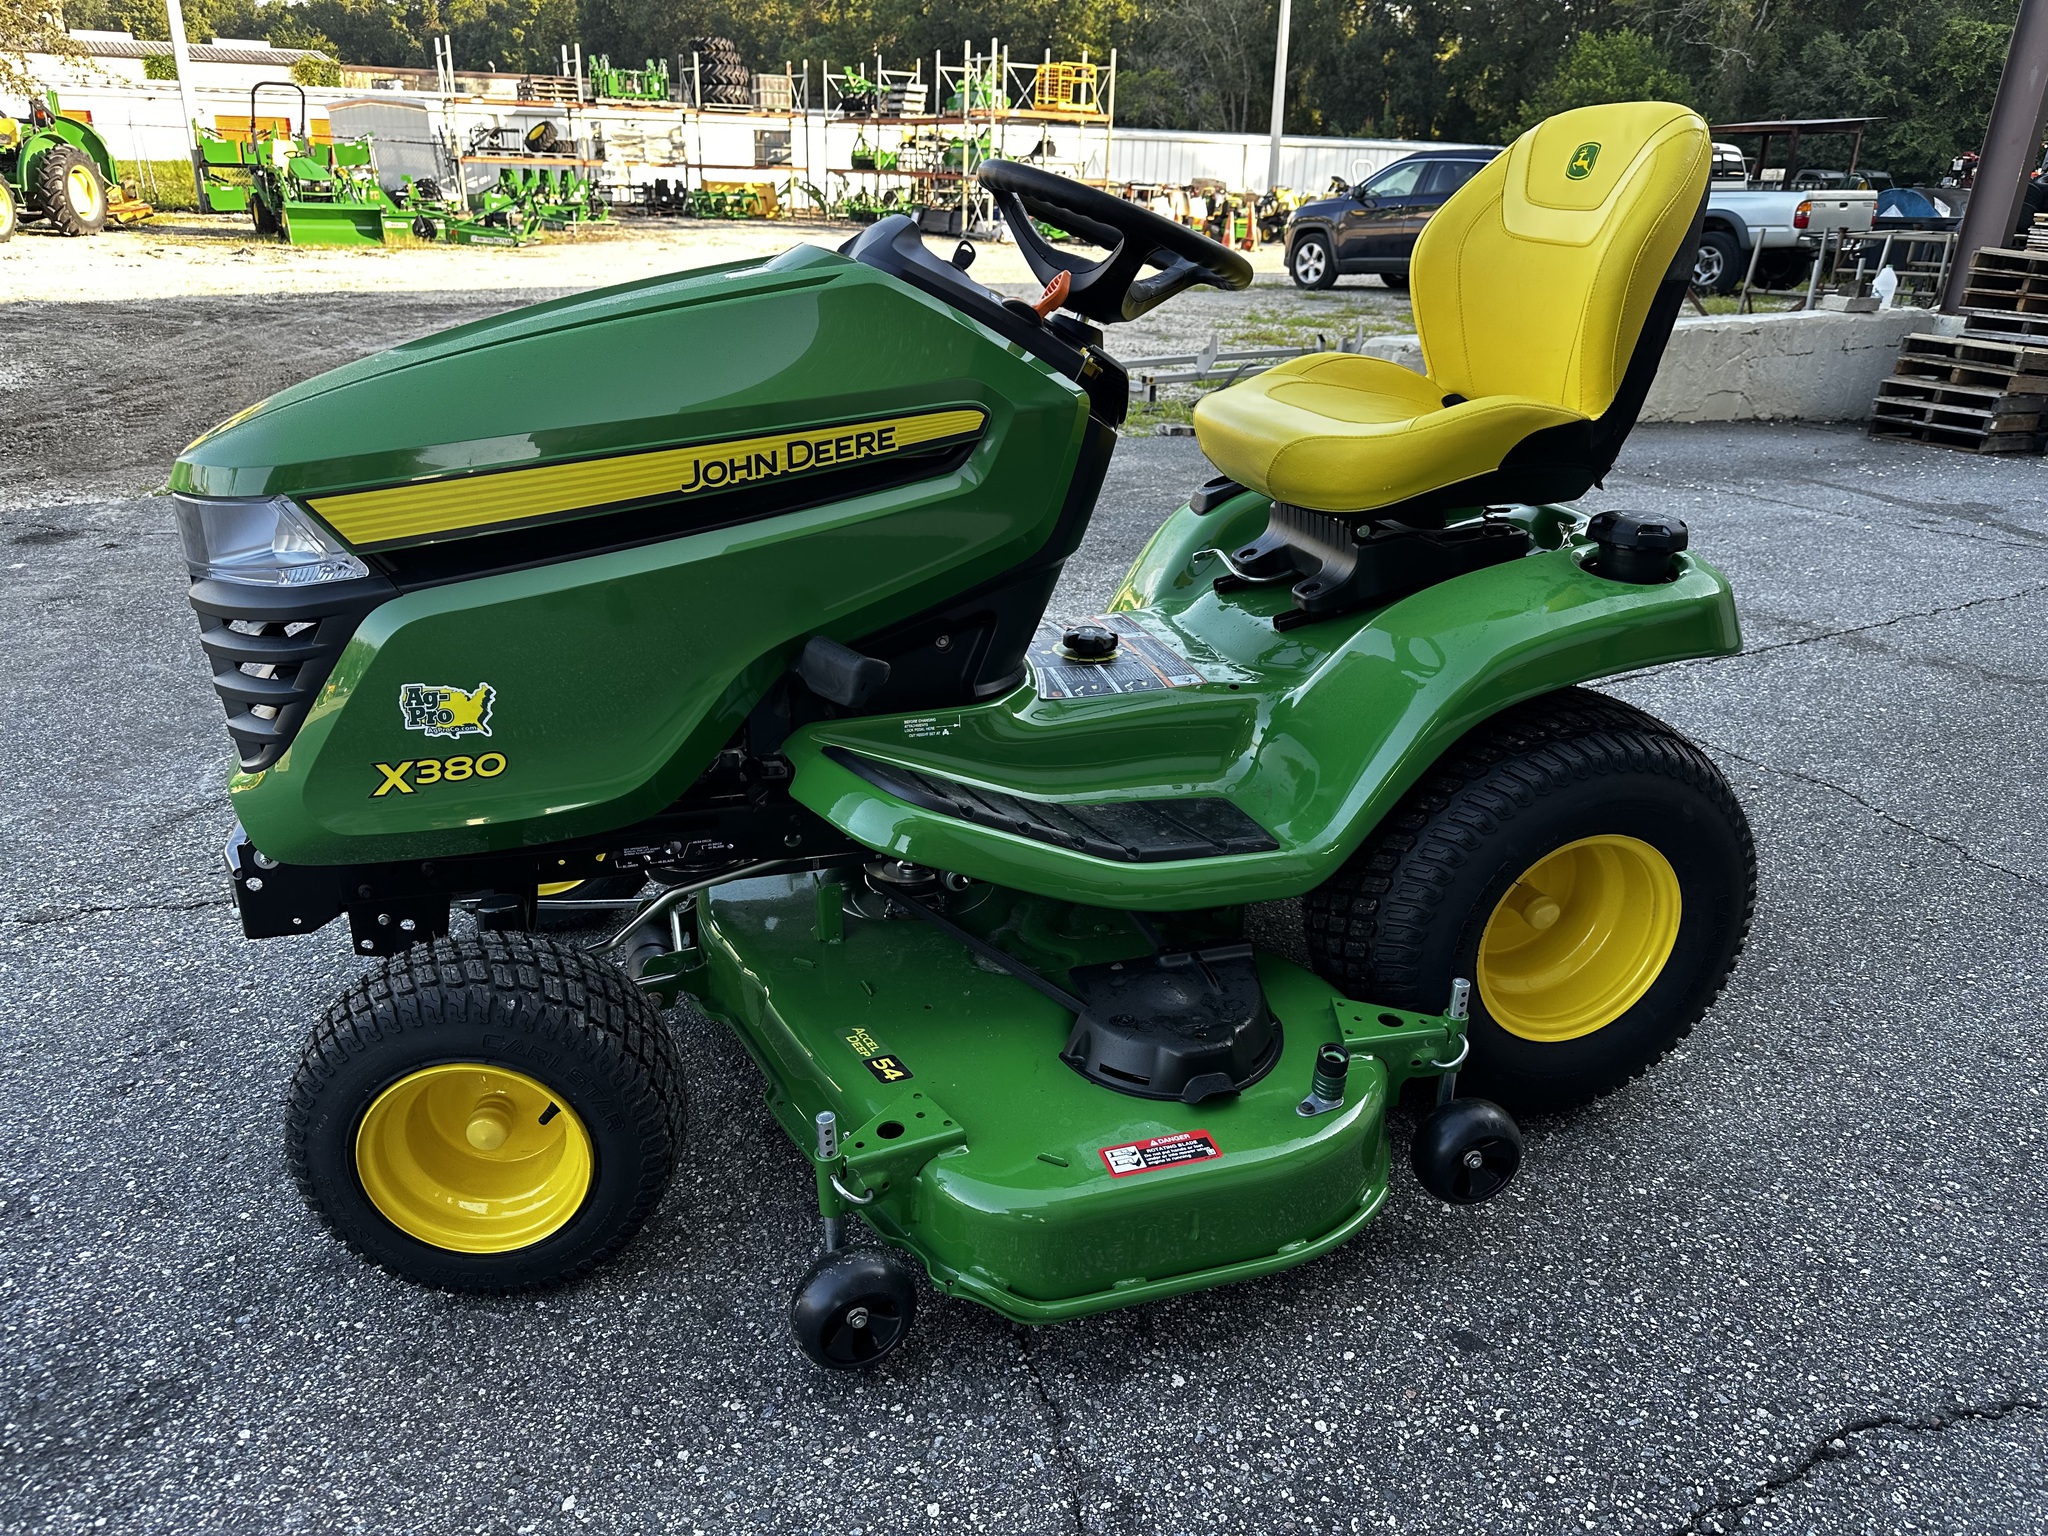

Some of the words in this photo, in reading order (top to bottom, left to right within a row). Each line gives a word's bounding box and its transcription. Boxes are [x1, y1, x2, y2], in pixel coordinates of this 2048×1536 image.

[681, 450, 780, 491] JOHN
[786, 426, 897, 472] DEERE
[404, 686, 450, 710] Ag-
[406, 706, 454, 727] Pro
[427, 725, 478, 735] AgProCo.com
[371, 752, 508, 797] X380
[845, 1035, 872, 1057] DEEP
[851, 1028, 879, 1053] ACCEL
[871, 1057, 905, 1081] 54
[482, 1033, 626, 1134] CARLSTAR
[1145, 1143, 1177, 1153] ROTATING
[1177, 1140, 1198, 1148] BLADE
[1157, 1134, 1191, 1144] DANGER
